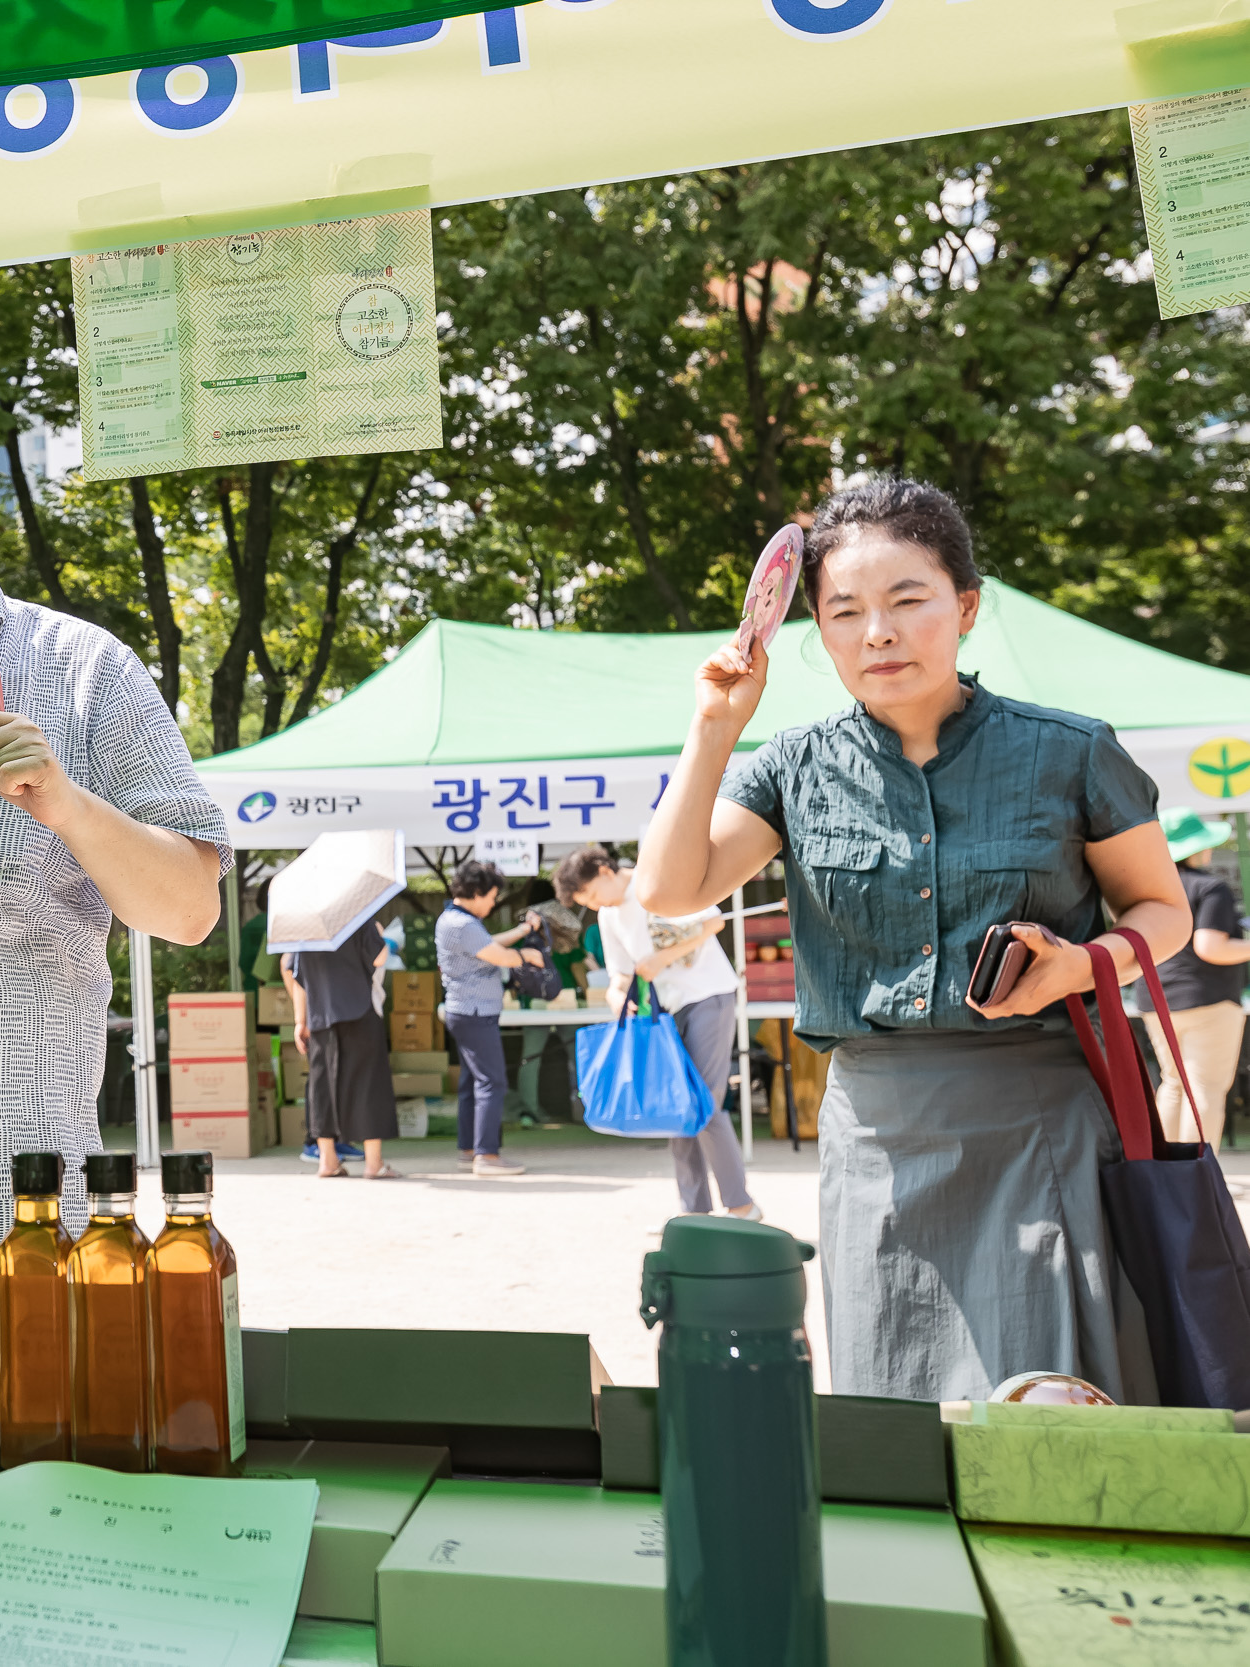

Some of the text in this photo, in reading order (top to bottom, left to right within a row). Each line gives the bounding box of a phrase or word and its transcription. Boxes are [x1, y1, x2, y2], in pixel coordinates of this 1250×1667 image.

[1157, 145, 1167, 158] 2
[1167, 200, 1176, 212] 3
[1174, 249, 1184, 261] 4
[89, 275, 94, 285] 1
[357, 307, 389, 321] 고소한
[93, 327, 100, 338] 2
[352, 321, 395, 336] 아리청정
[359, 336, 390, 349] 참기름
[96, 377, 103, 387] 3
[99, 422, 105, 431] 4
[286, 794, 363, 815] 광진구
[432, 774, 616, 833] 광진구
